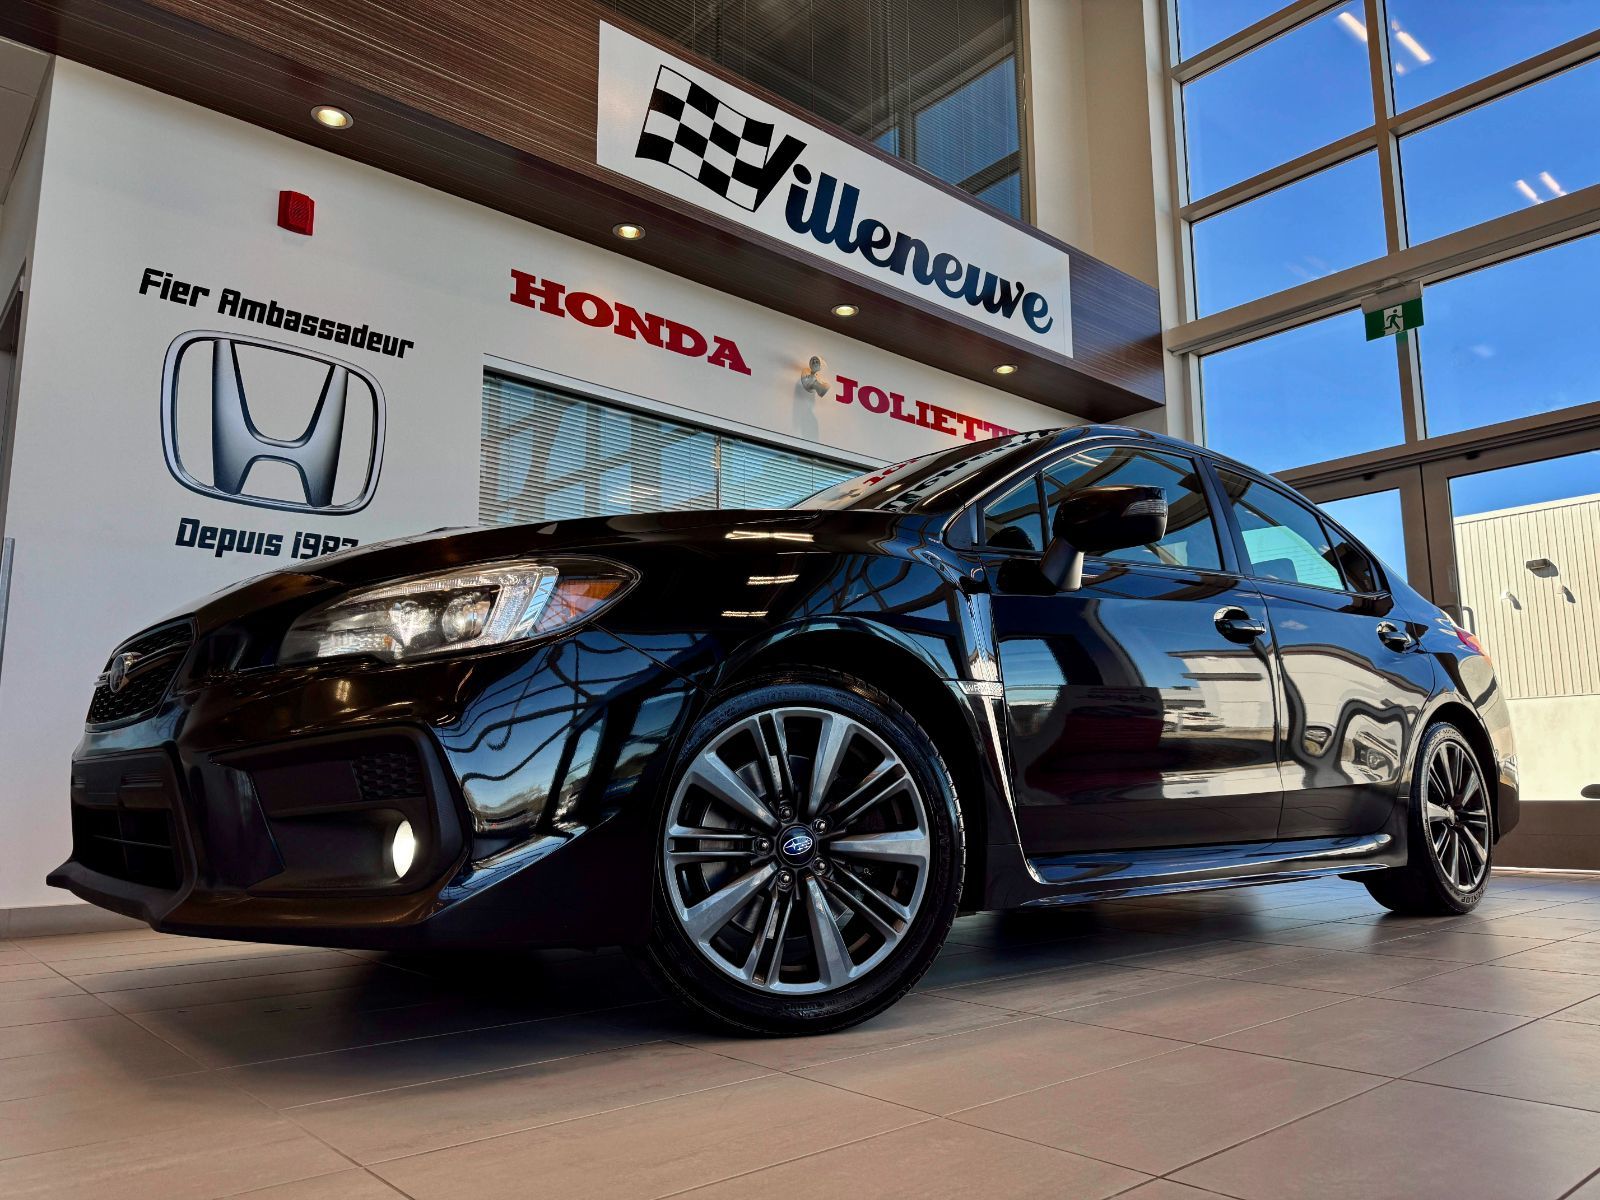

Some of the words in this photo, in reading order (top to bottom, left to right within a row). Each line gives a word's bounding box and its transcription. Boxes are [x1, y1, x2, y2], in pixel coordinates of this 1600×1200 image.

[732, 133, 1053, 334] Villeneuve
[138, 267, 210, 308] Fier
[217, 287, 415, 359] Ambassadeur
[510, 268, 752, 376] HONDA
[835, 374, 1020, 442] JOLIETT
[175, 517, 284, 558] Depuis
